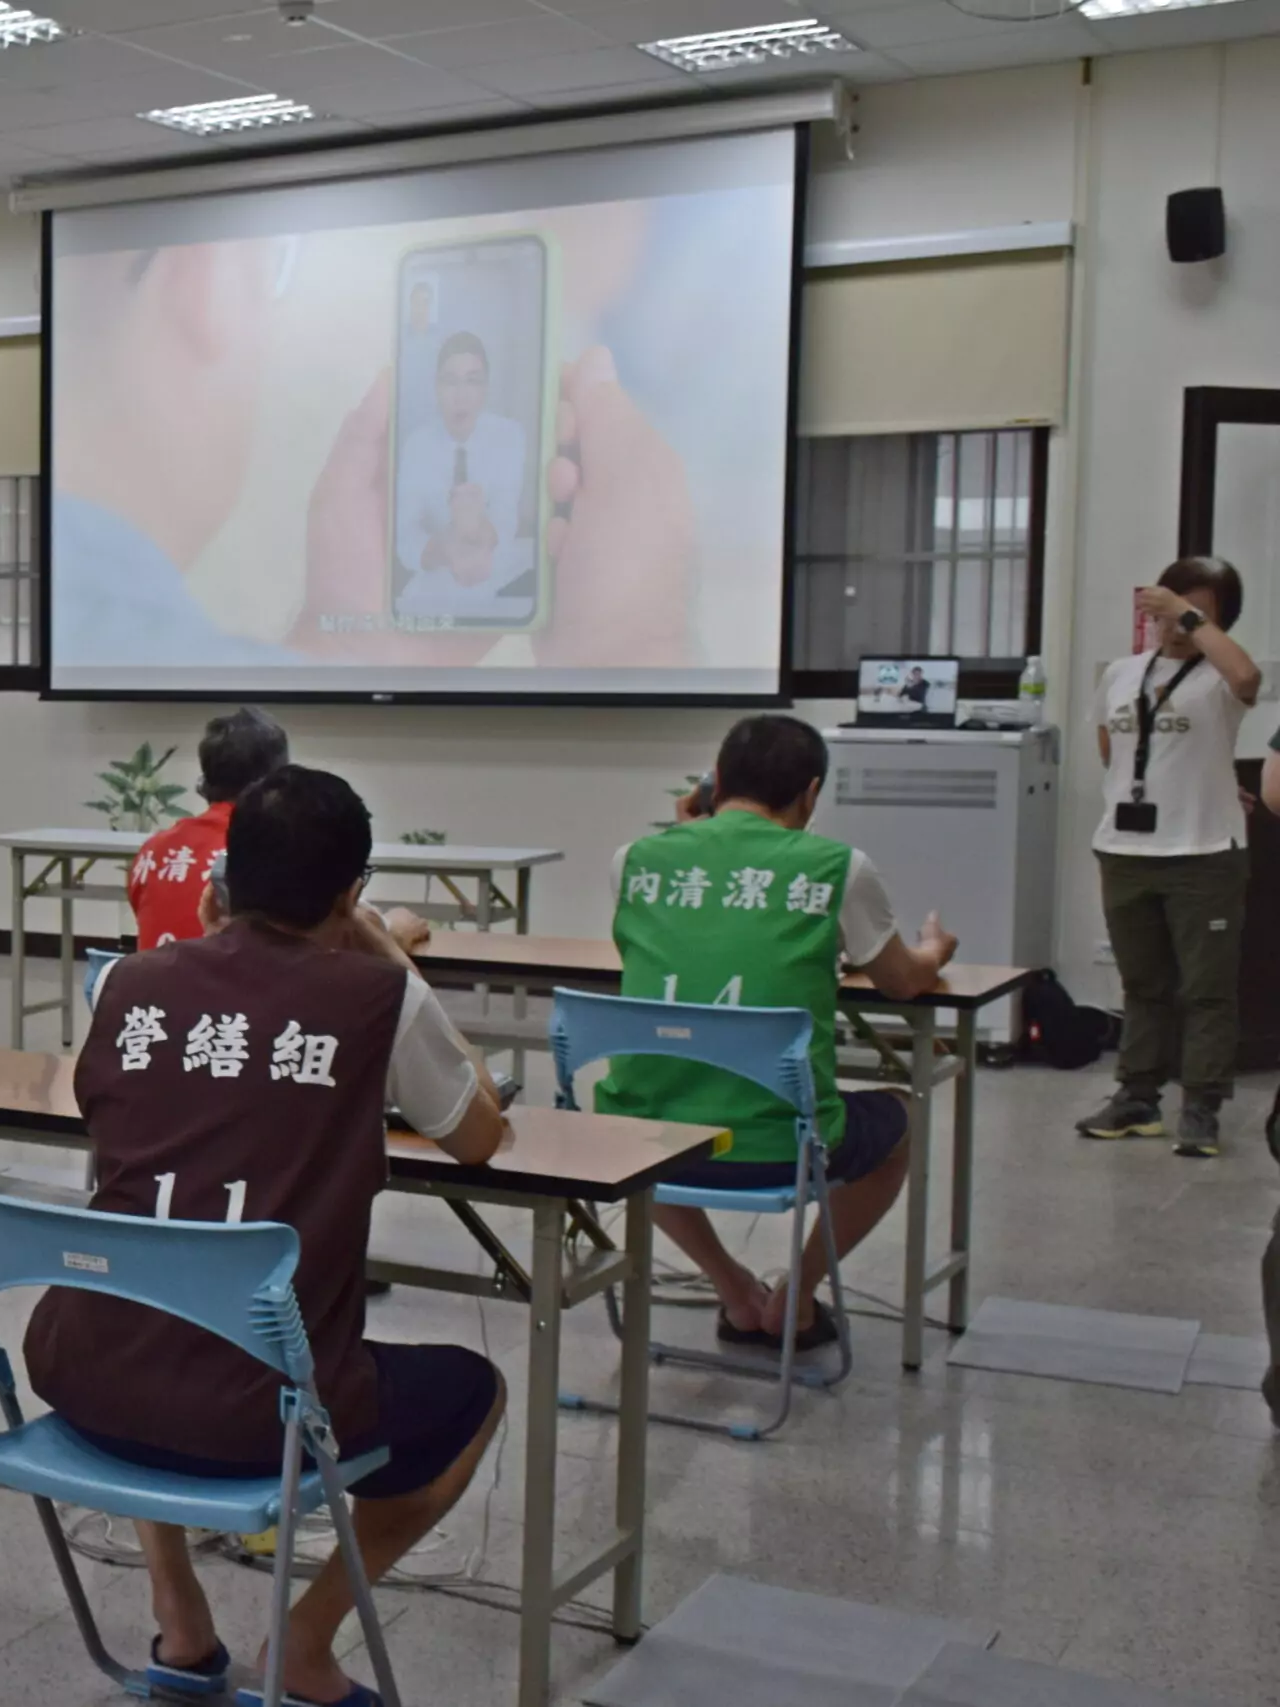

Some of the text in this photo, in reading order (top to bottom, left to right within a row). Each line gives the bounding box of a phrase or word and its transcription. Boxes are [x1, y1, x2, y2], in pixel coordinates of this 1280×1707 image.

[1109, 715, 1191, 734] adas
[627, 866, 834, 916] 內清潔組
[116, 1006, 339, 1087] 營繕組
[154, 1172, 247, 1223] 11
